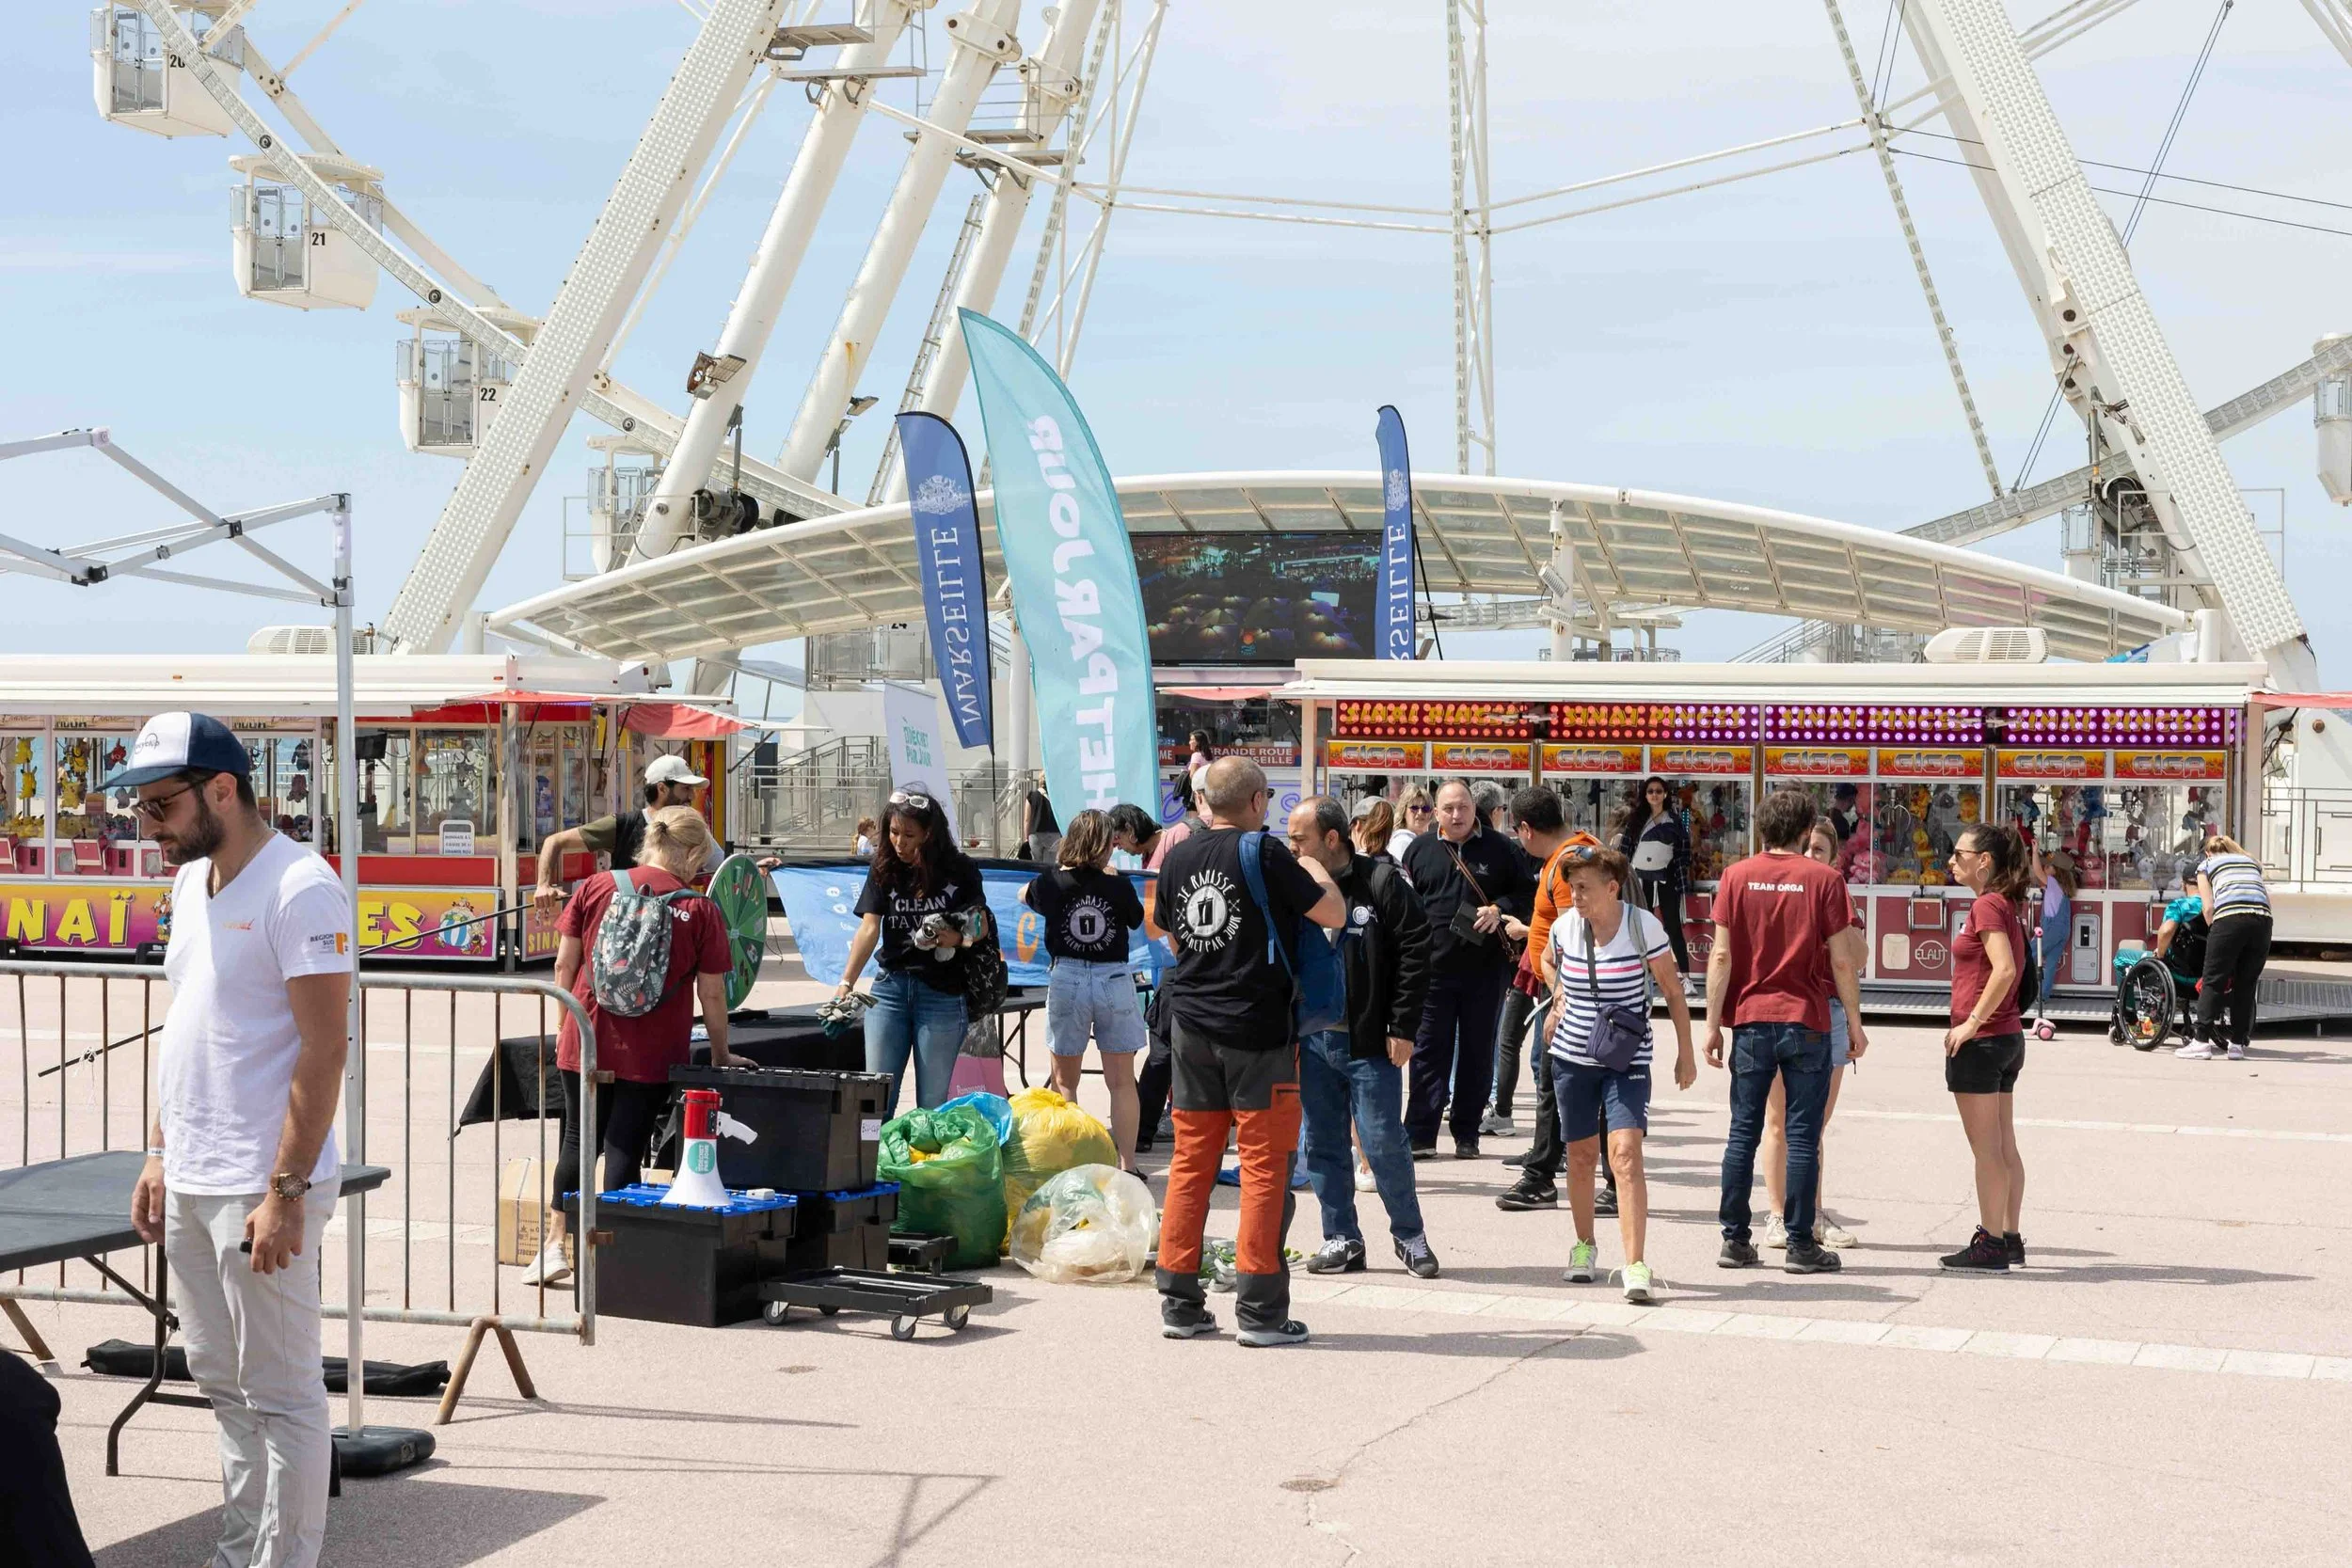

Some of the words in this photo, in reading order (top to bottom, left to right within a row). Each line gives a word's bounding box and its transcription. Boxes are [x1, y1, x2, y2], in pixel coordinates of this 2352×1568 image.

[311, 232, 326, 245] 21
[480, 388, 497, 401] 22
[1211, 747, 1256, 755] RANDE
[1259, 748, 1293, 756] ROUE
[1342, 746, 1406, 767] GIGA
[1446, 745, 1511, 768] GIGA
[1557, 748, 1623, 770] GIGA
[1666, 750, 1733, 771] GIGA
[1781, 751, 1850, 773] GIGA
[1894, 752, 1964, 775] GIGA
[2014, 753, 2087, 777] GIGA
[2132, 753, 2205, 777] GIGA
[1177, 885, 1192, 903] JE
[1748, 881, 1775, 891] TEAM
[1777, 883, 1804, 893] ORGA
[895, 895, 946, 912] CLEAN
[1205, 936, 1226, 953] PAR
[1223, 914, 1242, 941] JOUR
